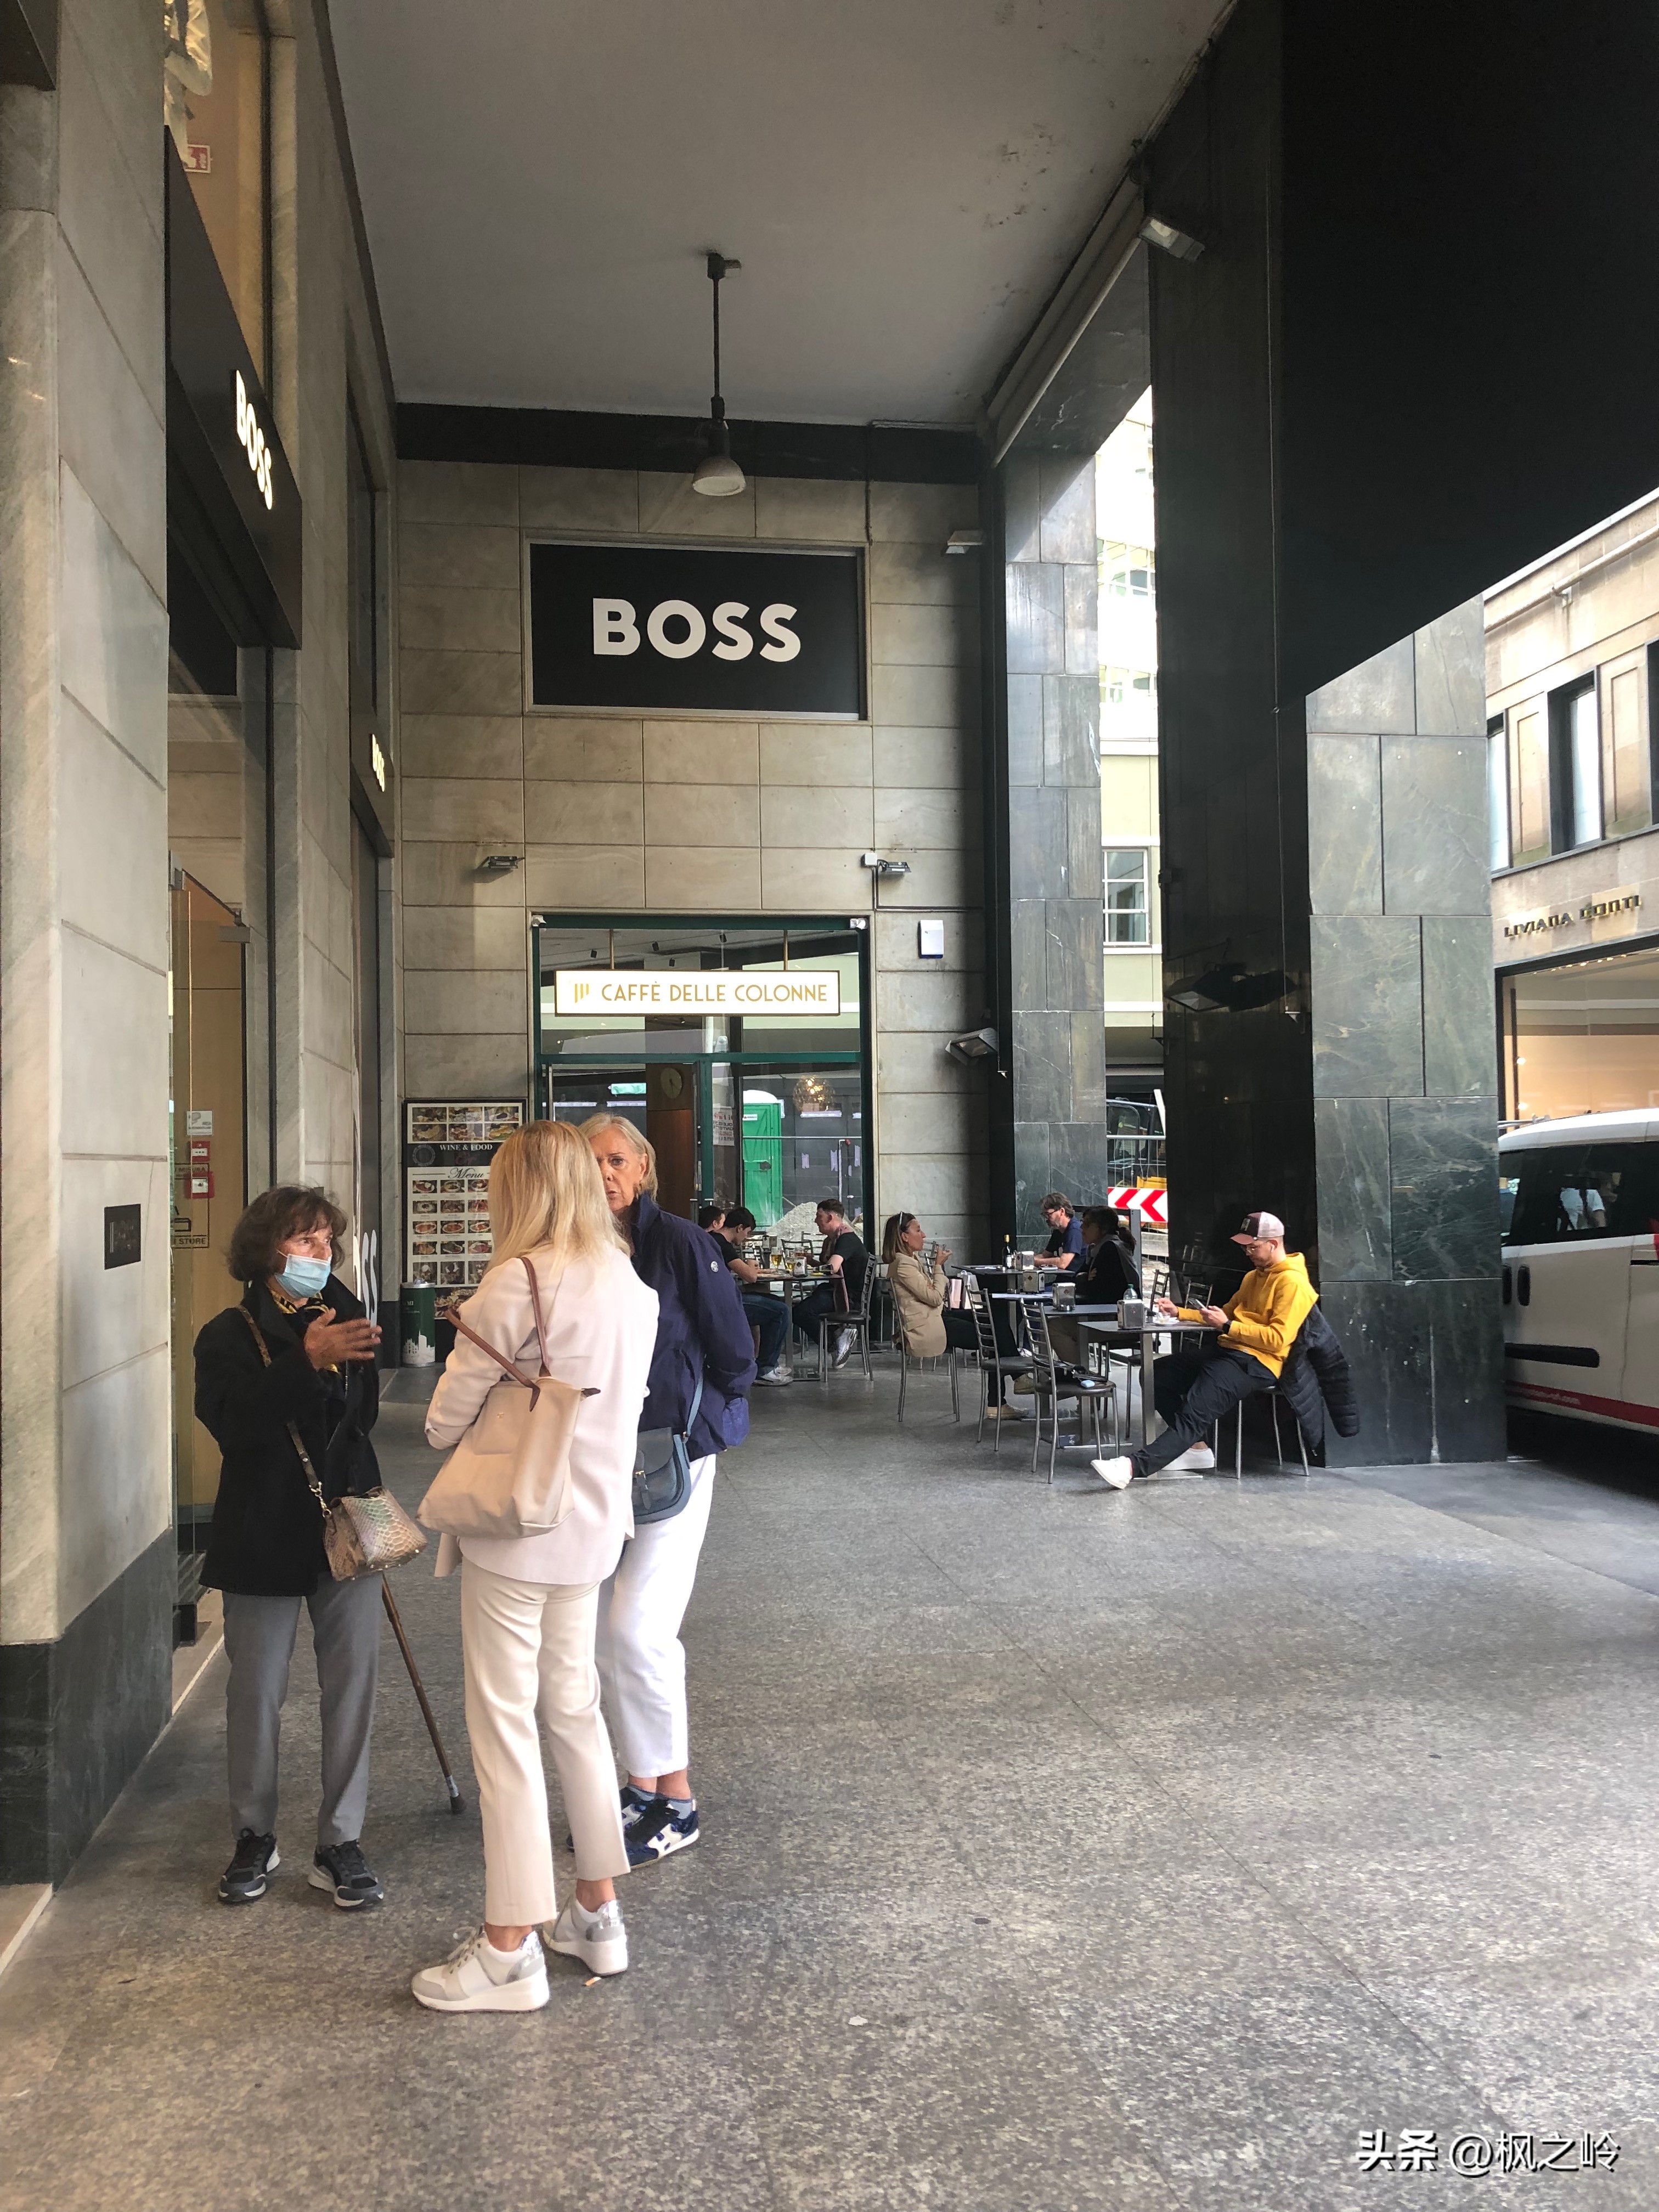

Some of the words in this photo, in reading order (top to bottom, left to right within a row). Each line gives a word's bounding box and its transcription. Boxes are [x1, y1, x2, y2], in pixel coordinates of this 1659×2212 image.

[236, 370, 273, 510] BOSS
[593, 597, 801, 663] BOSS
[373, 734, 385, 792] BOSS
[1504, 912, 1573, 938] LIVIANA
[1579, 895, 1640, 919] CONTI
[601, 981, 660, 1002] CAFFÈ
[670, 984, 726, 1002] DELLE
[735, 984, 827, 1002] COLONNE
[448, 1167, 484, 1178] Menu
